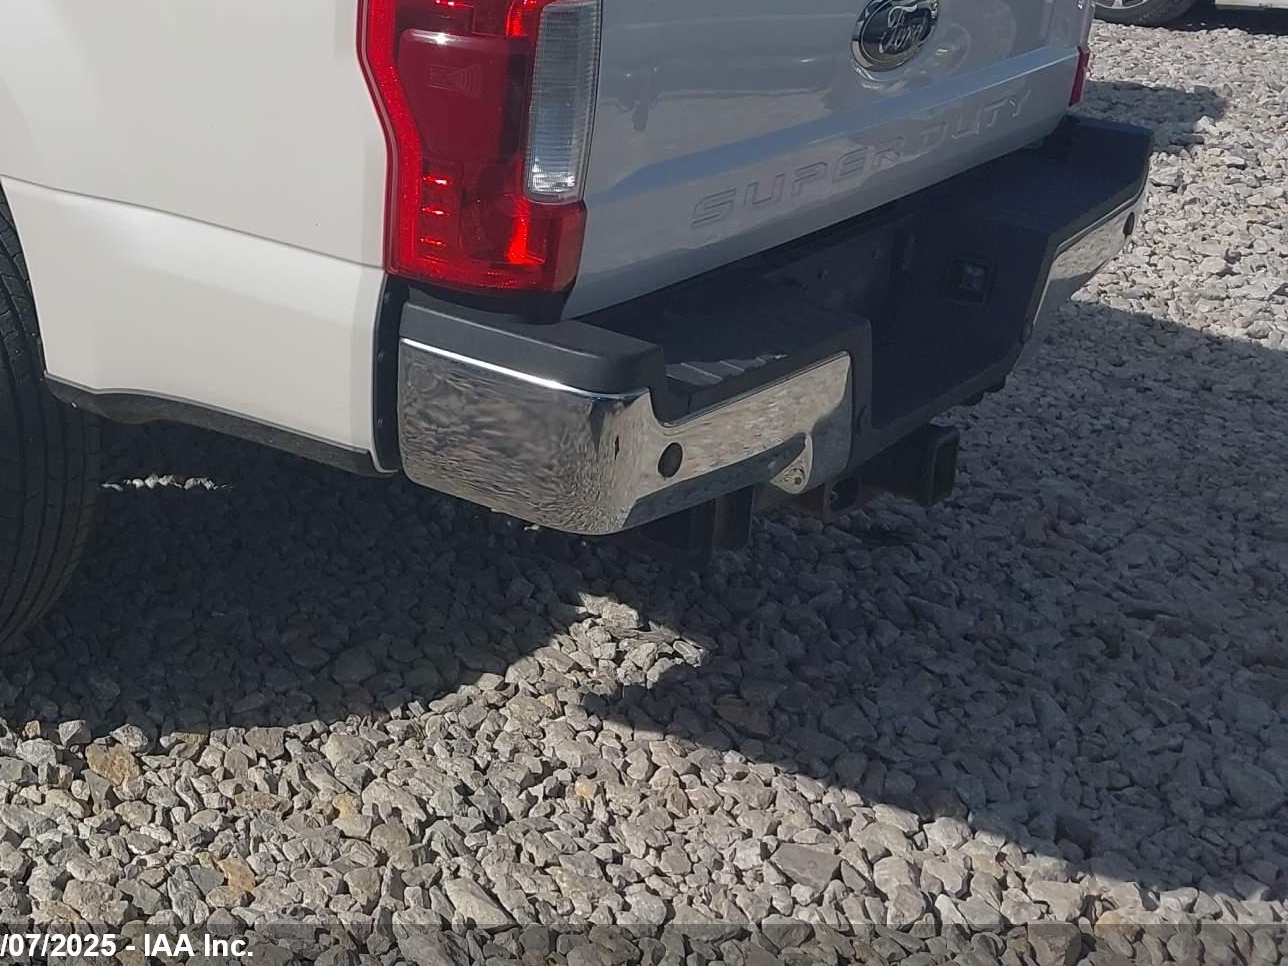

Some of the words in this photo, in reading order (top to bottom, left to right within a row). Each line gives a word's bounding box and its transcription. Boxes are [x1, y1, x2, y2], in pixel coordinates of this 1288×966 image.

[877, 4, 929, 54] Ford
[690, 135, 905, 226] SUPER
[914, 89, 1032, 152] DUTY
